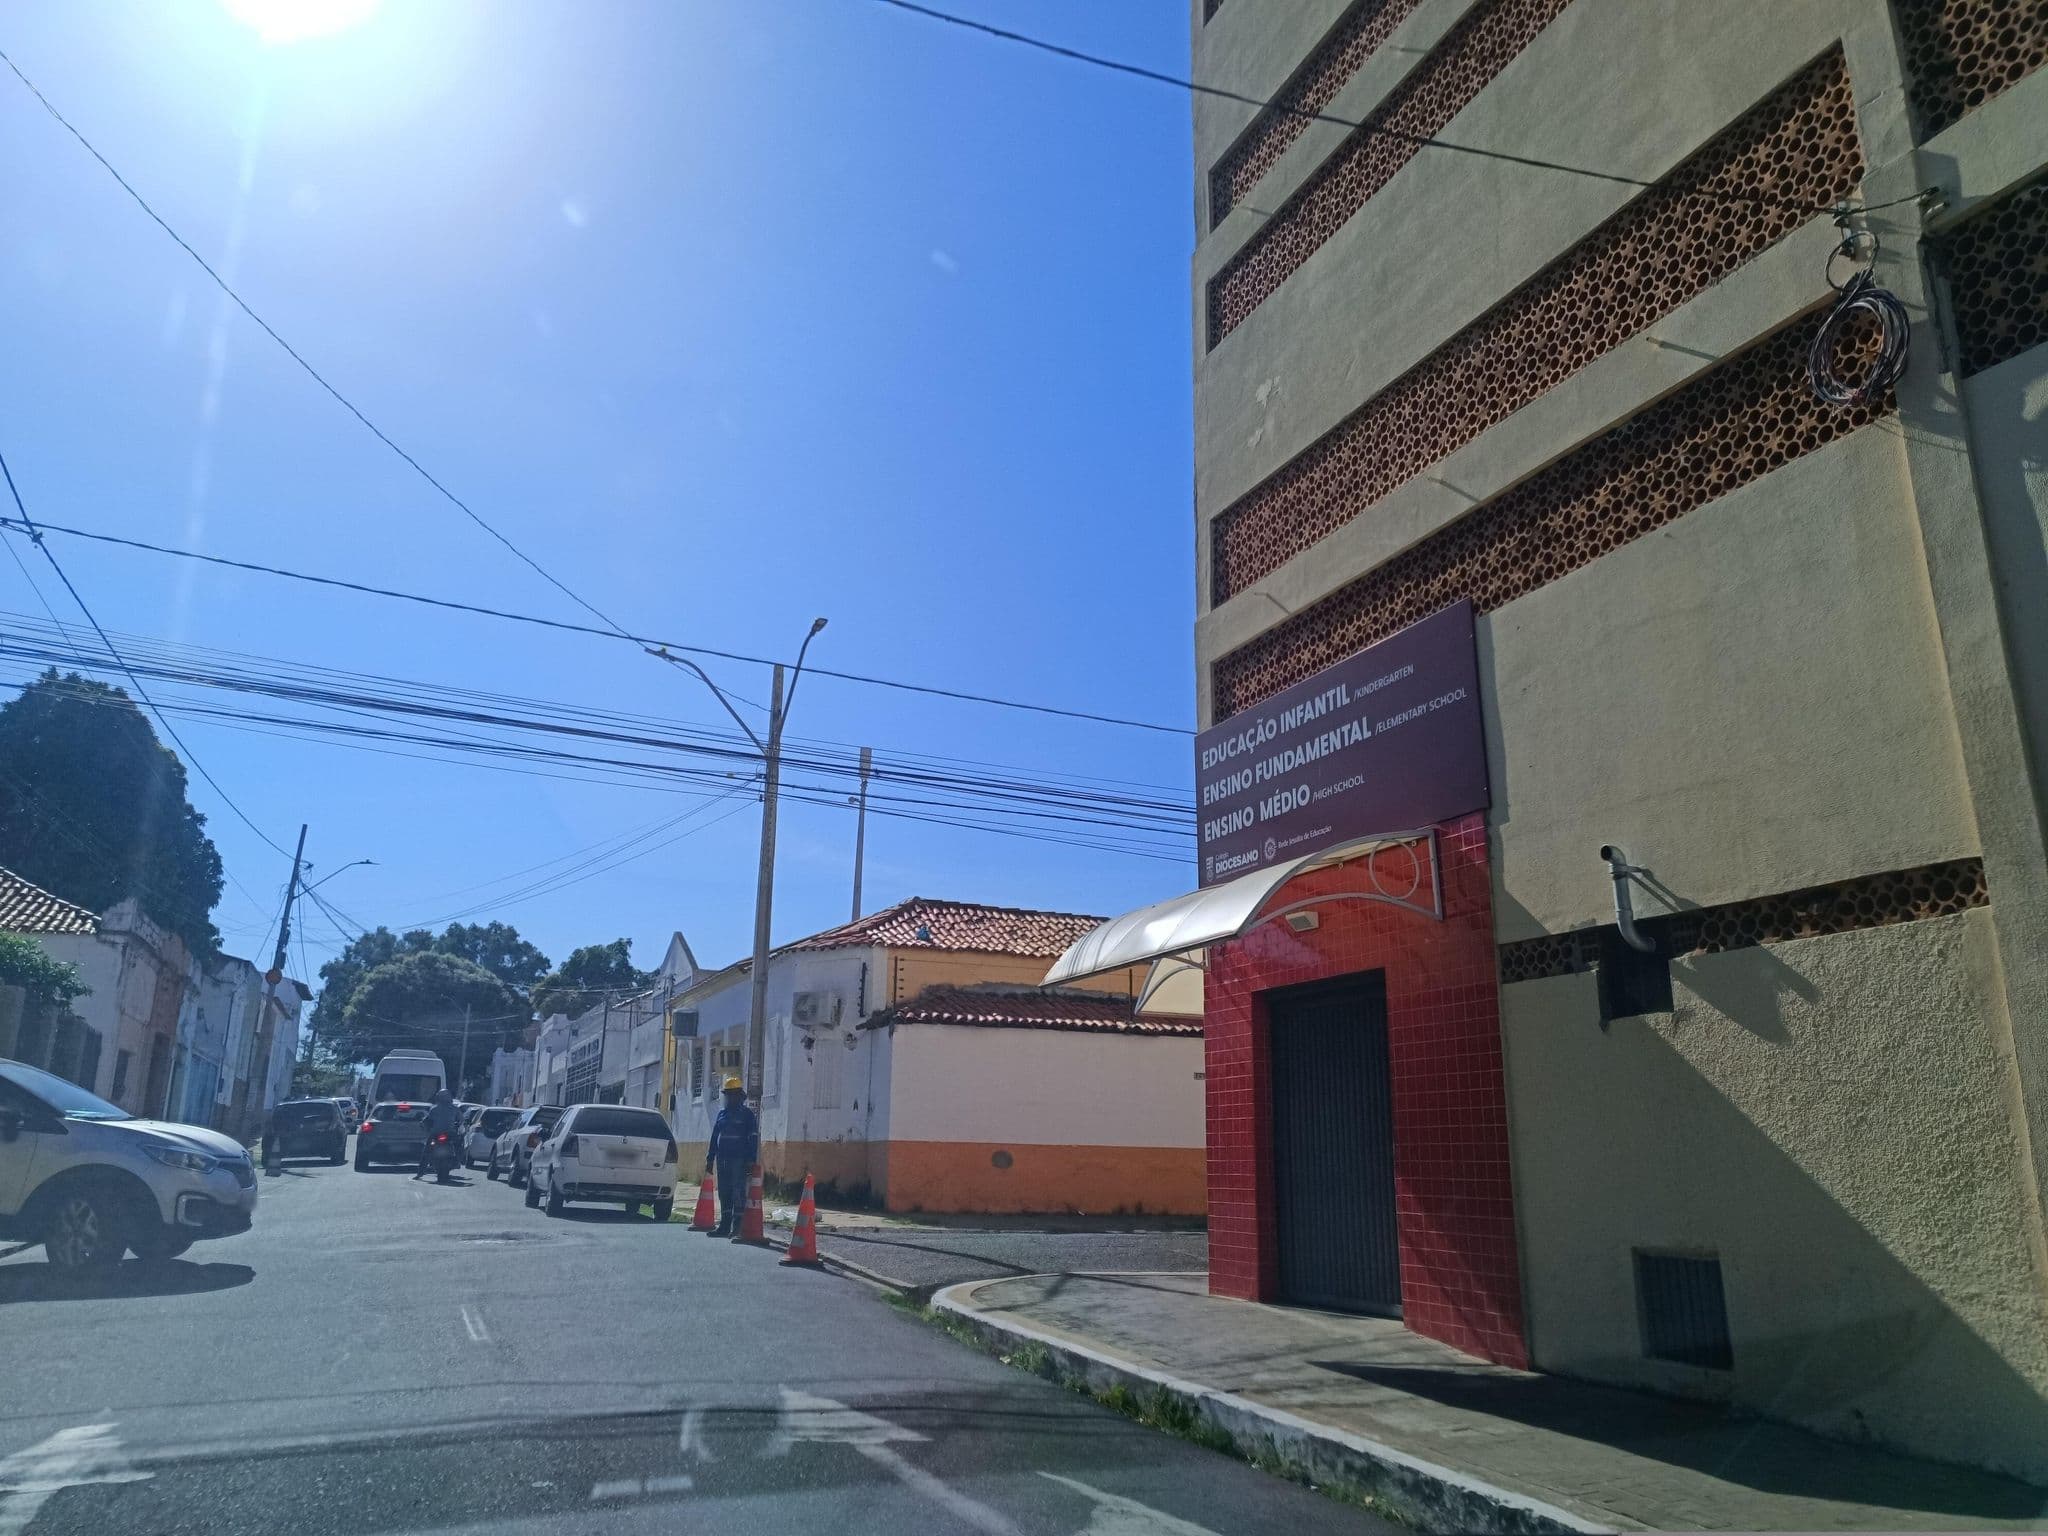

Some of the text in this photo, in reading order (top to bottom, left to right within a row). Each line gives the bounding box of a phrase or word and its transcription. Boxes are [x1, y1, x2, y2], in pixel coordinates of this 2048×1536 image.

[1202, 664, 1414, 770] EDUCAÇÃO INFANTIL /KINDERGARTEN
[1203, 687, 1467, 806] ENSINO FUNDAMENTAL /ELEMENTARY SCHOOL
[1204, 774, 1365, 843] ENSINO MÉDIO /HIGH SCHOOL
[1215, 849, 1259, 874] DIOCESANO
